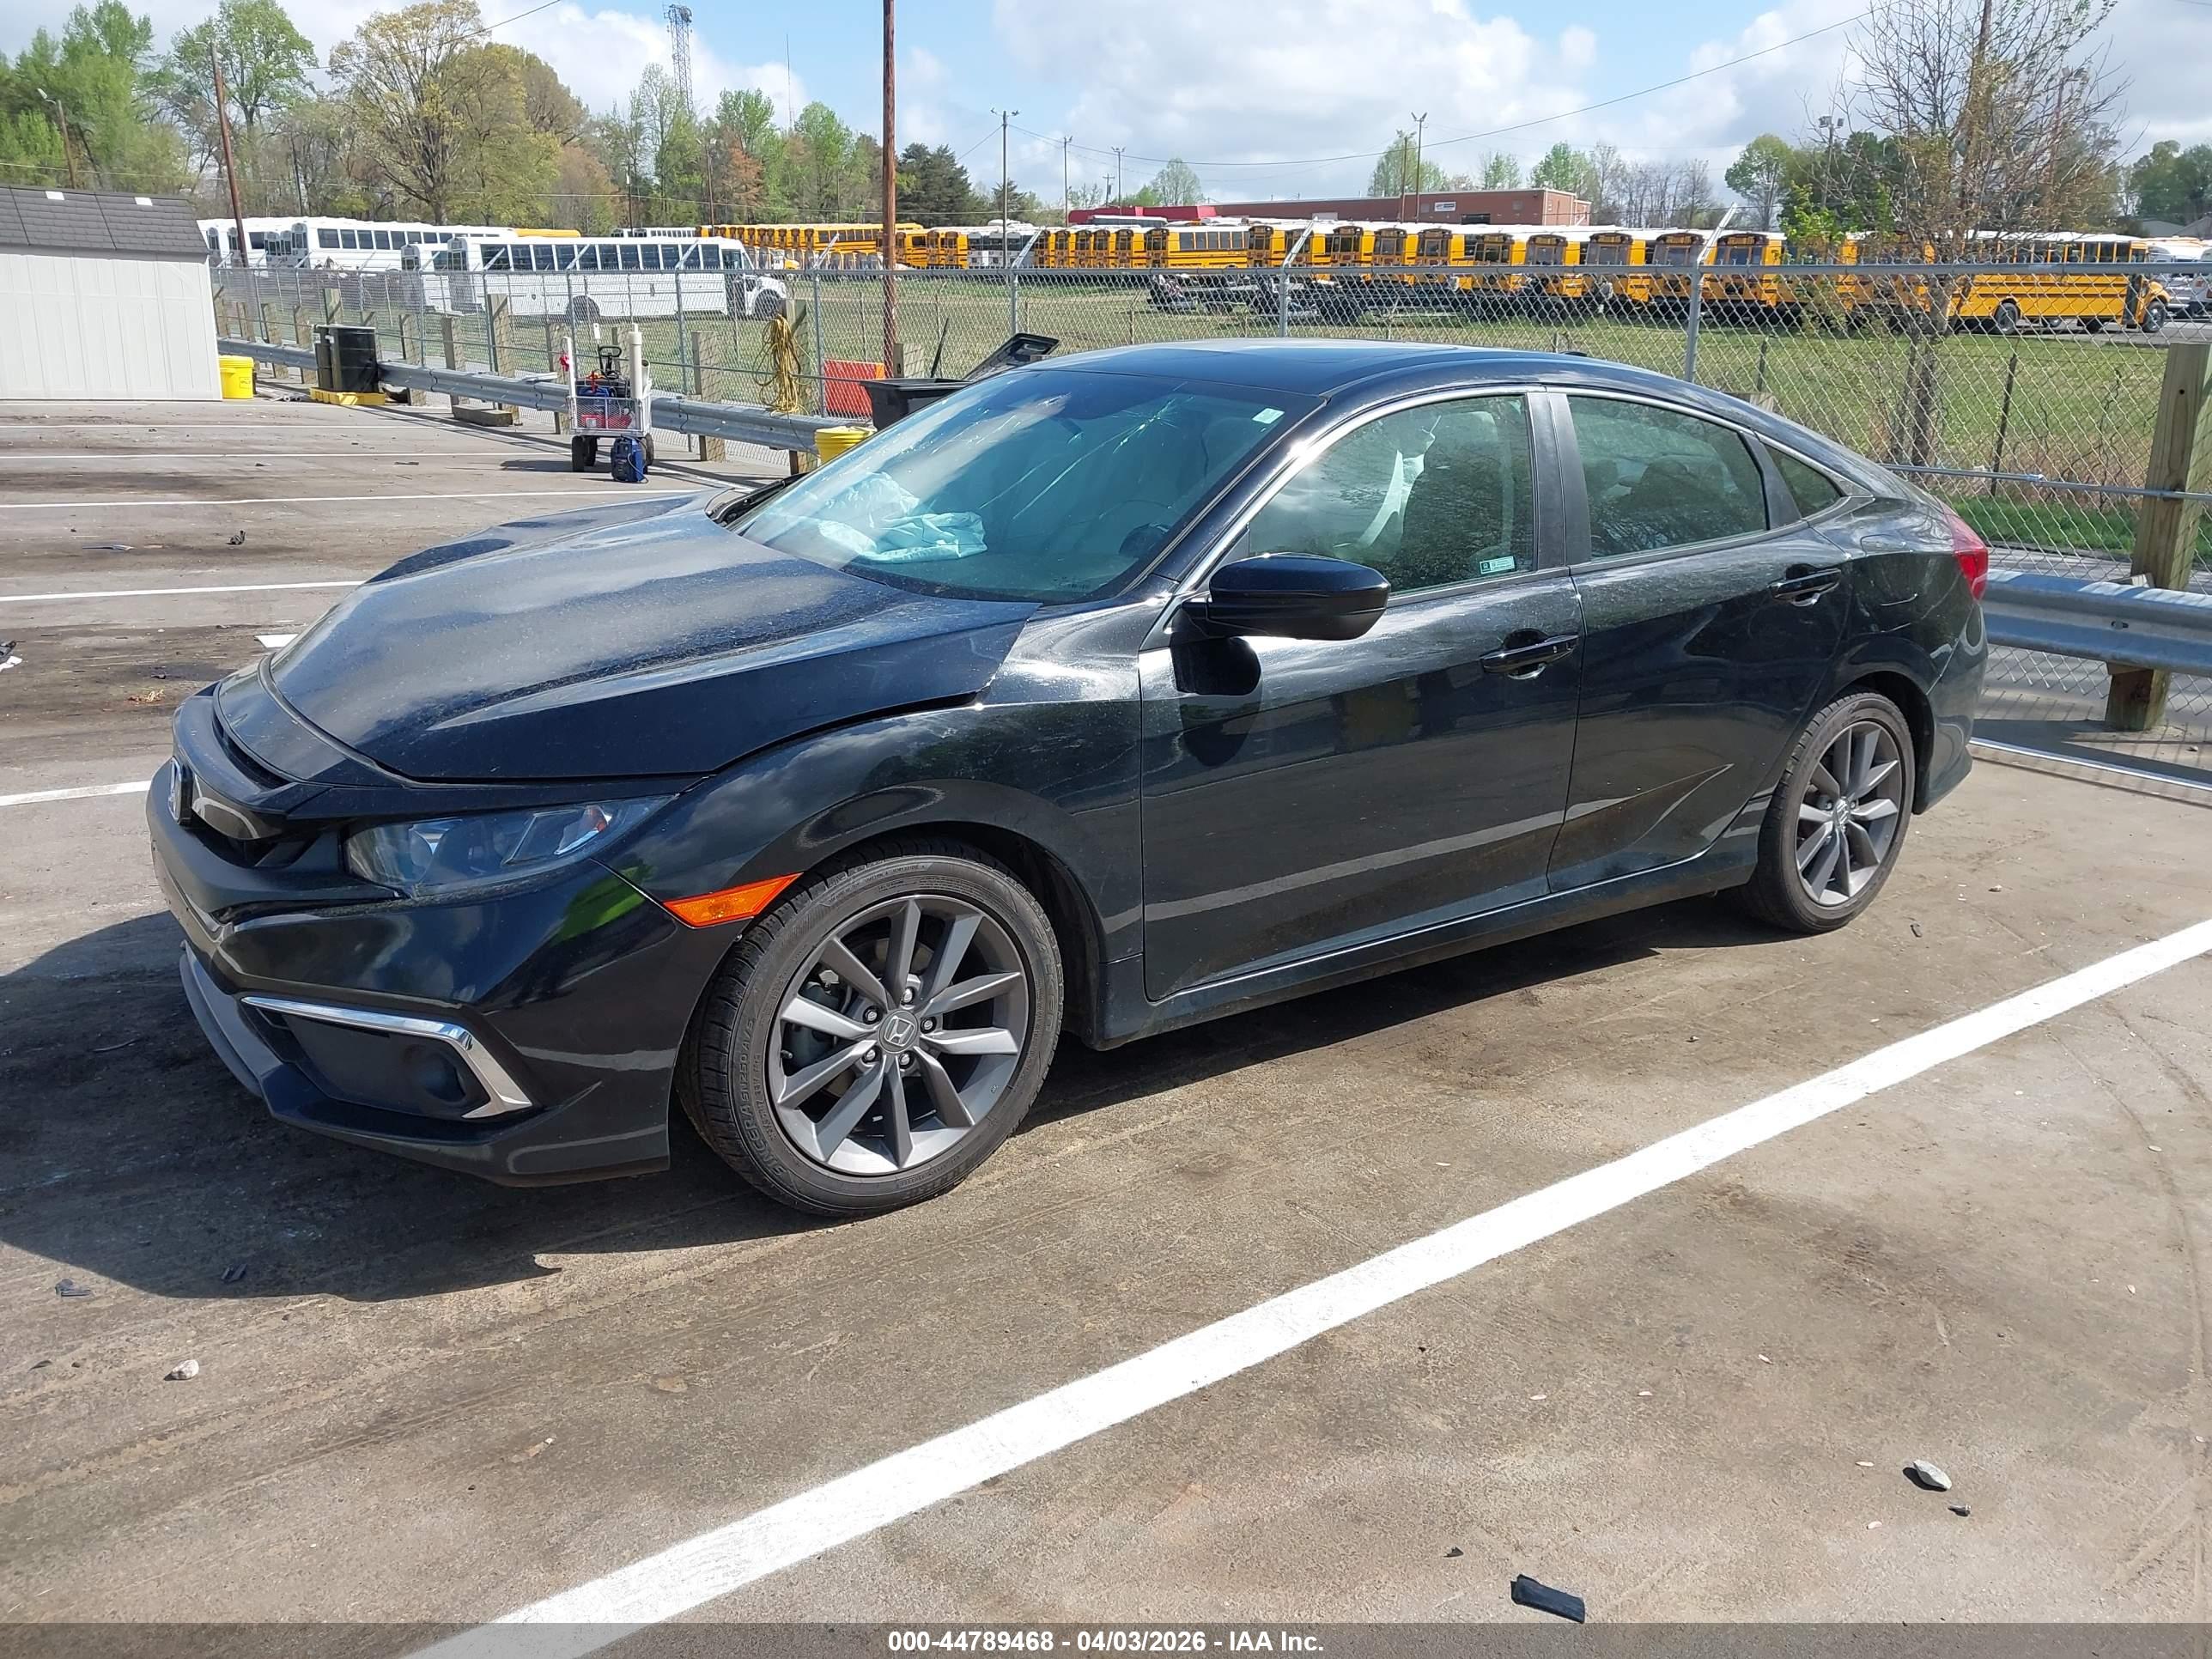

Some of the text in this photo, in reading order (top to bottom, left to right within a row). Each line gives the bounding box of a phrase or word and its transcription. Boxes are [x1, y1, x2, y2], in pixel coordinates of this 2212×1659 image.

[740, 1018, 755, 1050] A/S
[738, 1054, 750, 1102] SN250
[738, 1104, 787, 1176] SINCERA
